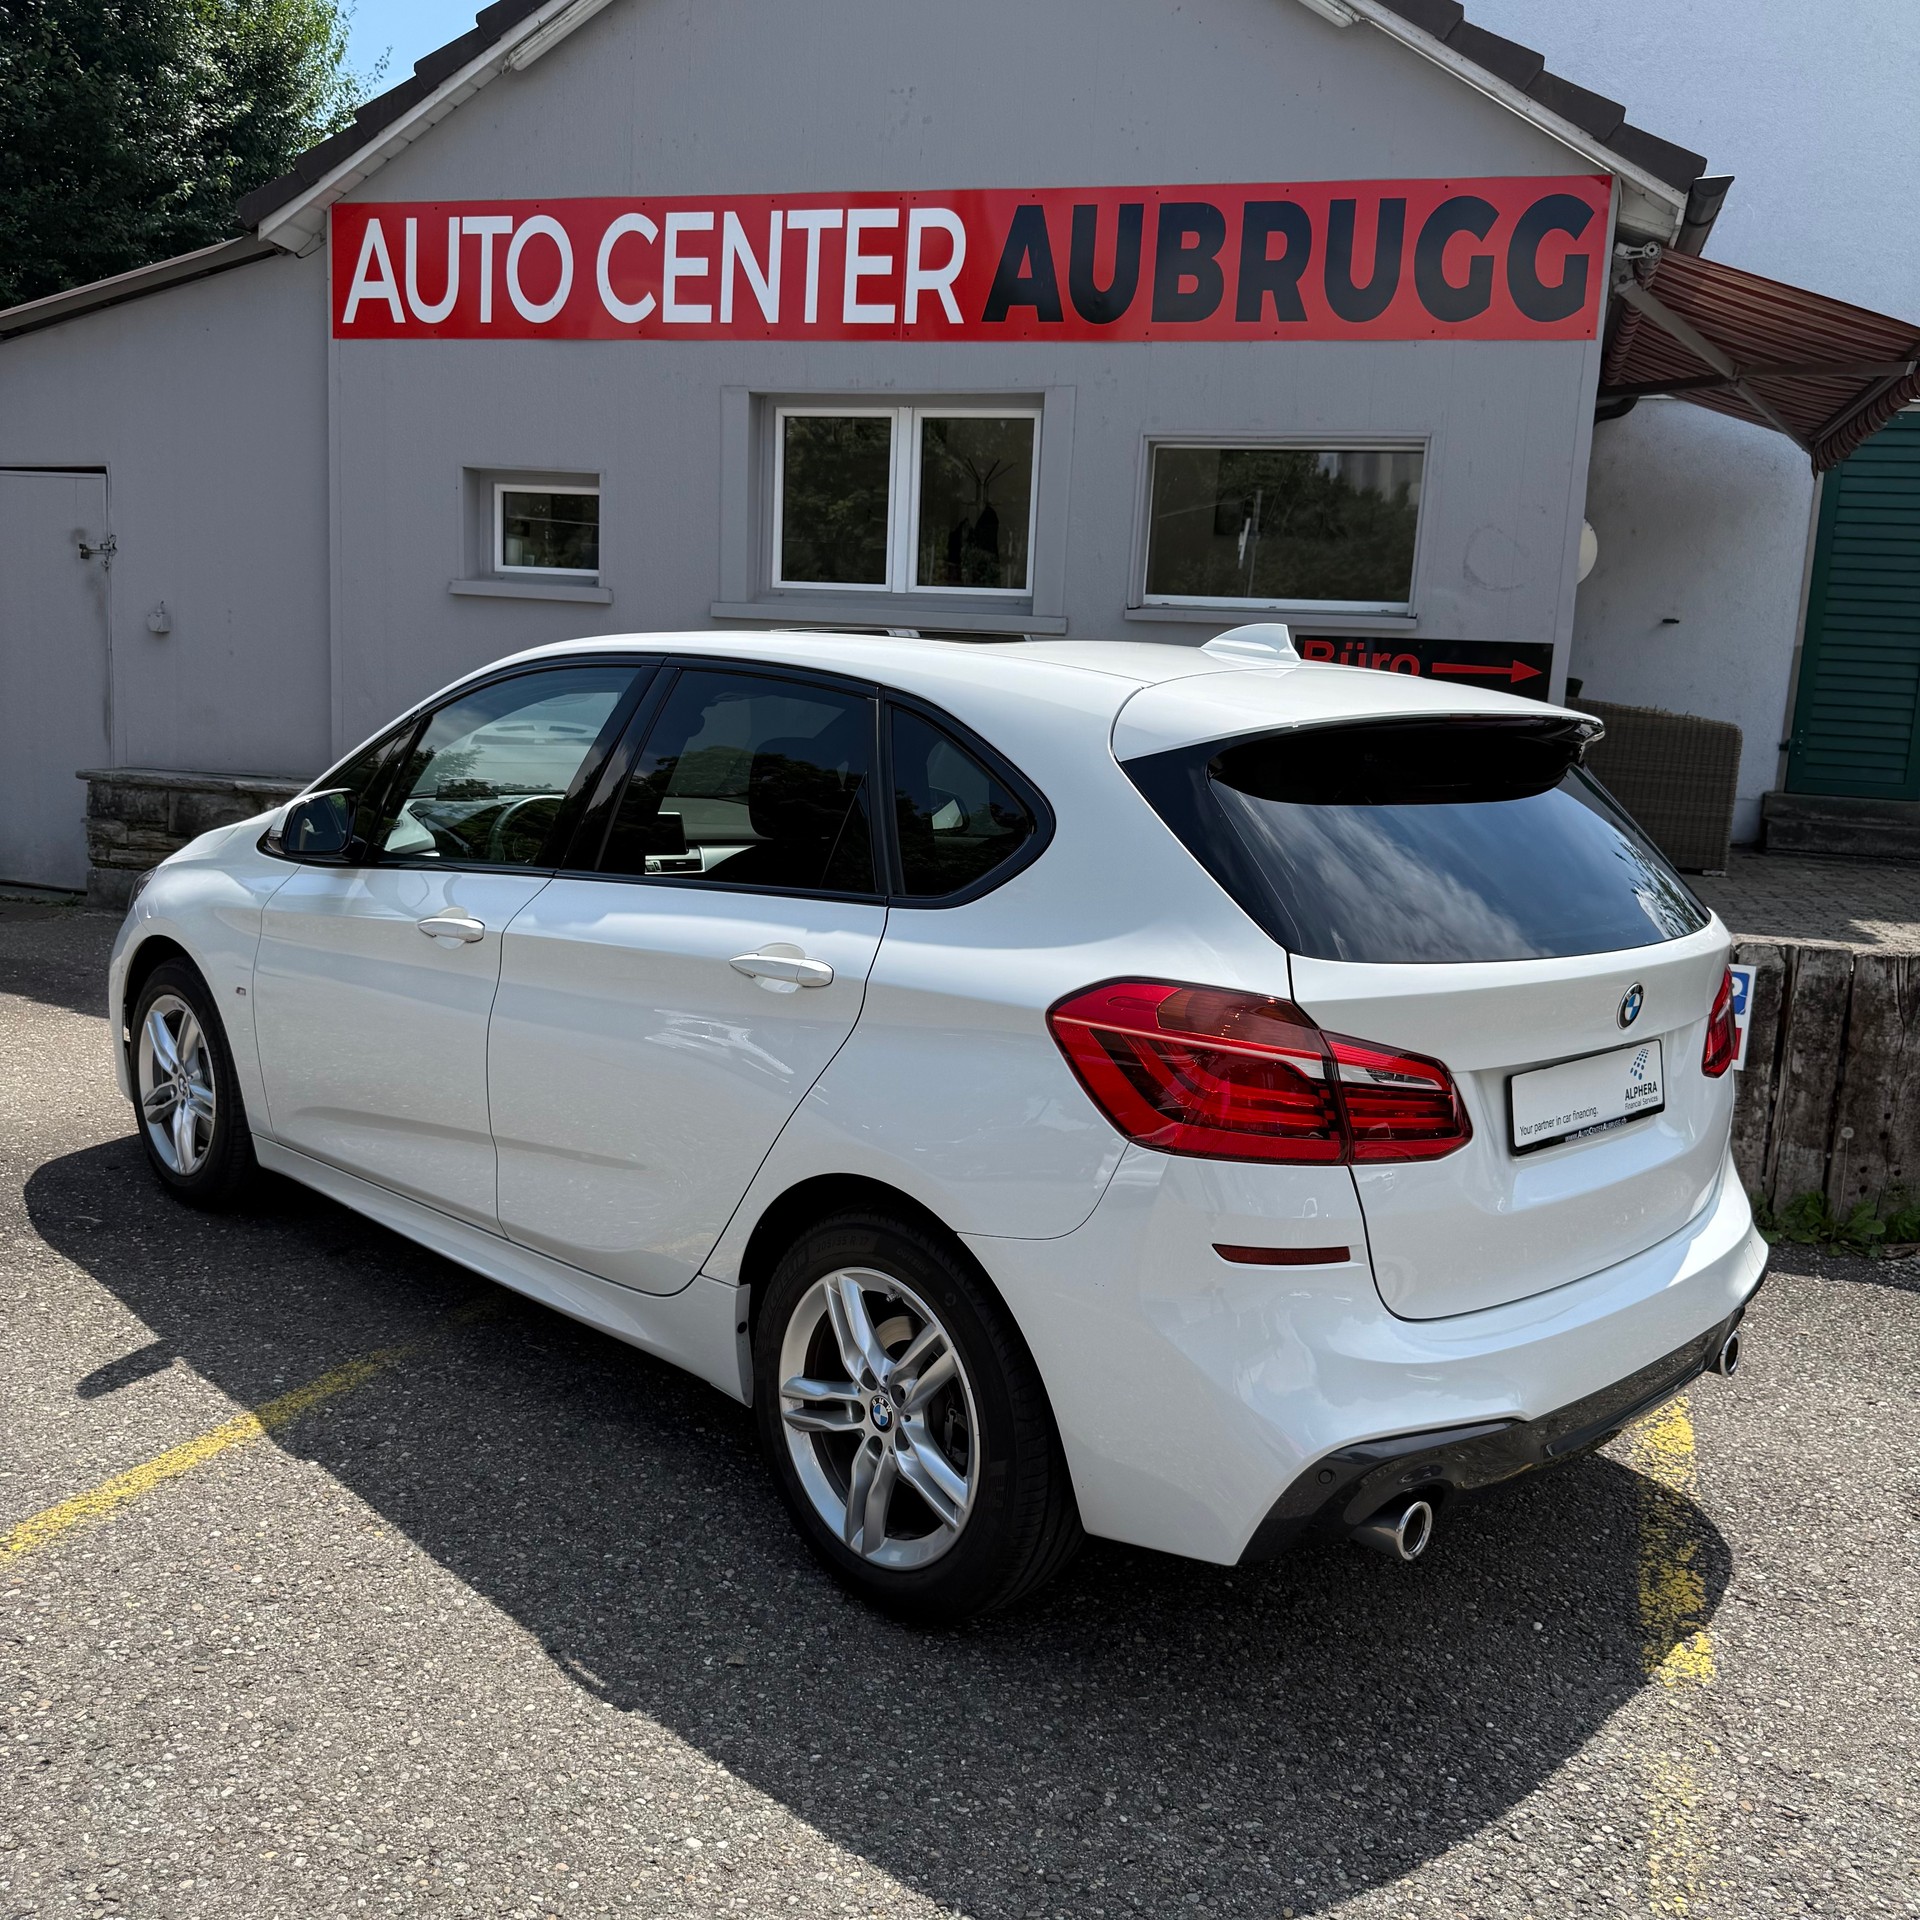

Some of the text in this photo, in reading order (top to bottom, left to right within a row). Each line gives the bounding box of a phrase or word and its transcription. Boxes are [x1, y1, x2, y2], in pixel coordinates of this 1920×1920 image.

[342, 193, 1594, 325] AUTO CENTER AUBRUGG
[1624, 1080, 1658, 1101] ALPHERA
[1624, 1095, 1658, 1110] Financial Services
[1519, 1106, 1599, 1136] Your partner in car financing.
[871, 1397, 893, 1413] BMW
